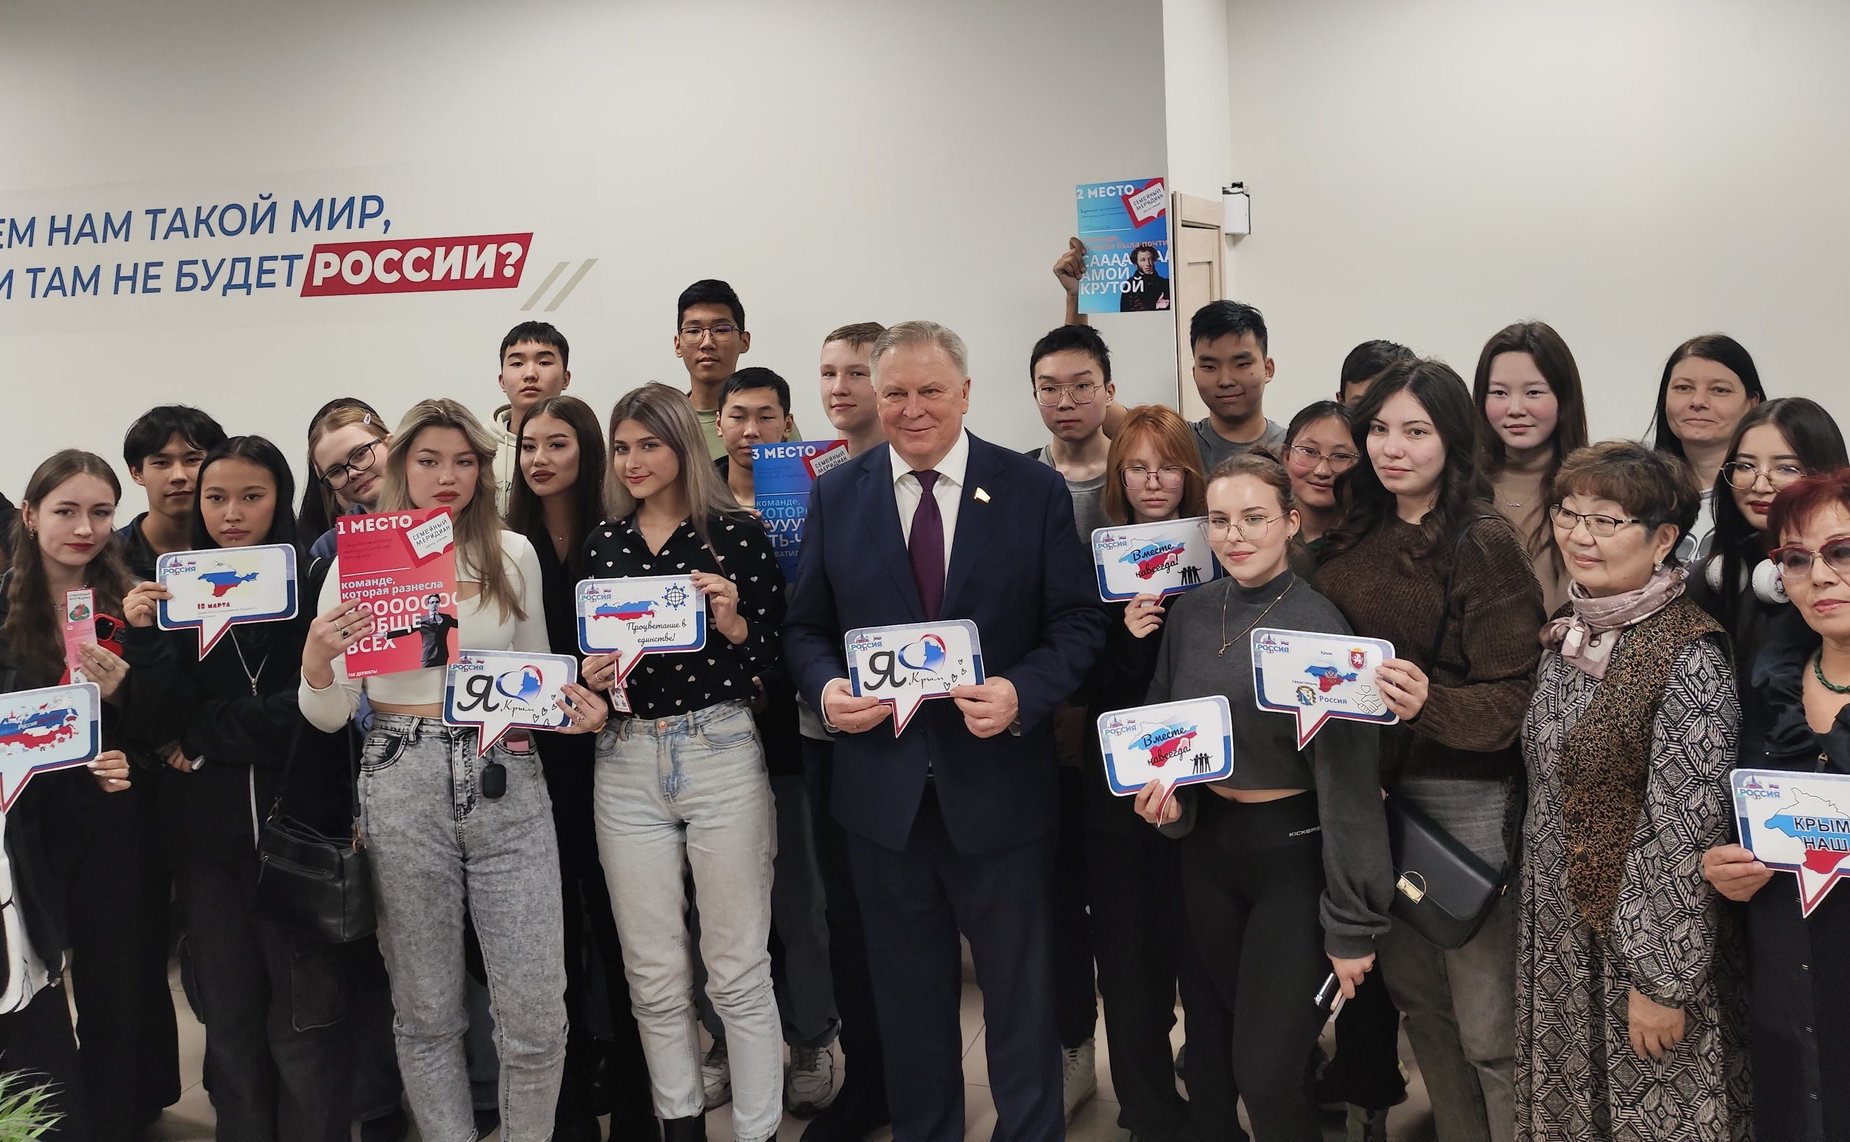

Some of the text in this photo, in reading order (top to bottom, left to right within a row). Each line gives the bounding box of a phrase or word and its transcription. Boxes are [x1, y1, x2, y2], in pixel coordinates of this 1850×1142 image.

[1077, 184, 1134, 199] 2 МЕСТО
[48, 211, 132, 247] НАМ
[145, 193, 277, 241] ТАКОЙ
[290, 195, 391, 236] МИР,
[312, 241, 525, 287] РОССИИ?
[26, 265, 102, 299] ТАМ
[114, 262, 164, 296] НЕ
[175, 254, 303, 297] БУДЕТ
[1080, 276, 1144, 295] КРУТОЙ
[752, 445, 816, 460] 3 МЕСТО
[338, 515, 413, 534] 1 МЕСТО
[412, 519, 448, 541] СЕМЕЙНЫЙ
[416, 526, 451, 546] МЕРИДИАН
[1098, 540, 1128, 549] РОССИЯ
[1131, 542, 1174, 562] Вместе
[163, 566, 196, 575] РОССИЯ
[341, 577, 396, 590] команде,
[342, 580, 444, 600] которая разнесла
[626, 618, 687, 634] Процветание в
[347, 636, 396, 655] ВСЕХ
[638, 633, 676, 647] единстве!
[850, 641, 882, 650] РОССИЯ
[1257, 644, 1290, 653] РОССИЯ
[864, 651, 907, 690] Я
[456, 675, 500, 712] Я
[1104, 724, 1137, 735] РОССИЯ
[1142, 726, 1186, 748] Вместе
[1148, 738, 1192, 766] навсегда!
[1740, 788, 1780, 798] РОССИЯ
[1794, 818, 1850, 833] КРЫМ
[1804, 836, 1848, 852] НАШ
